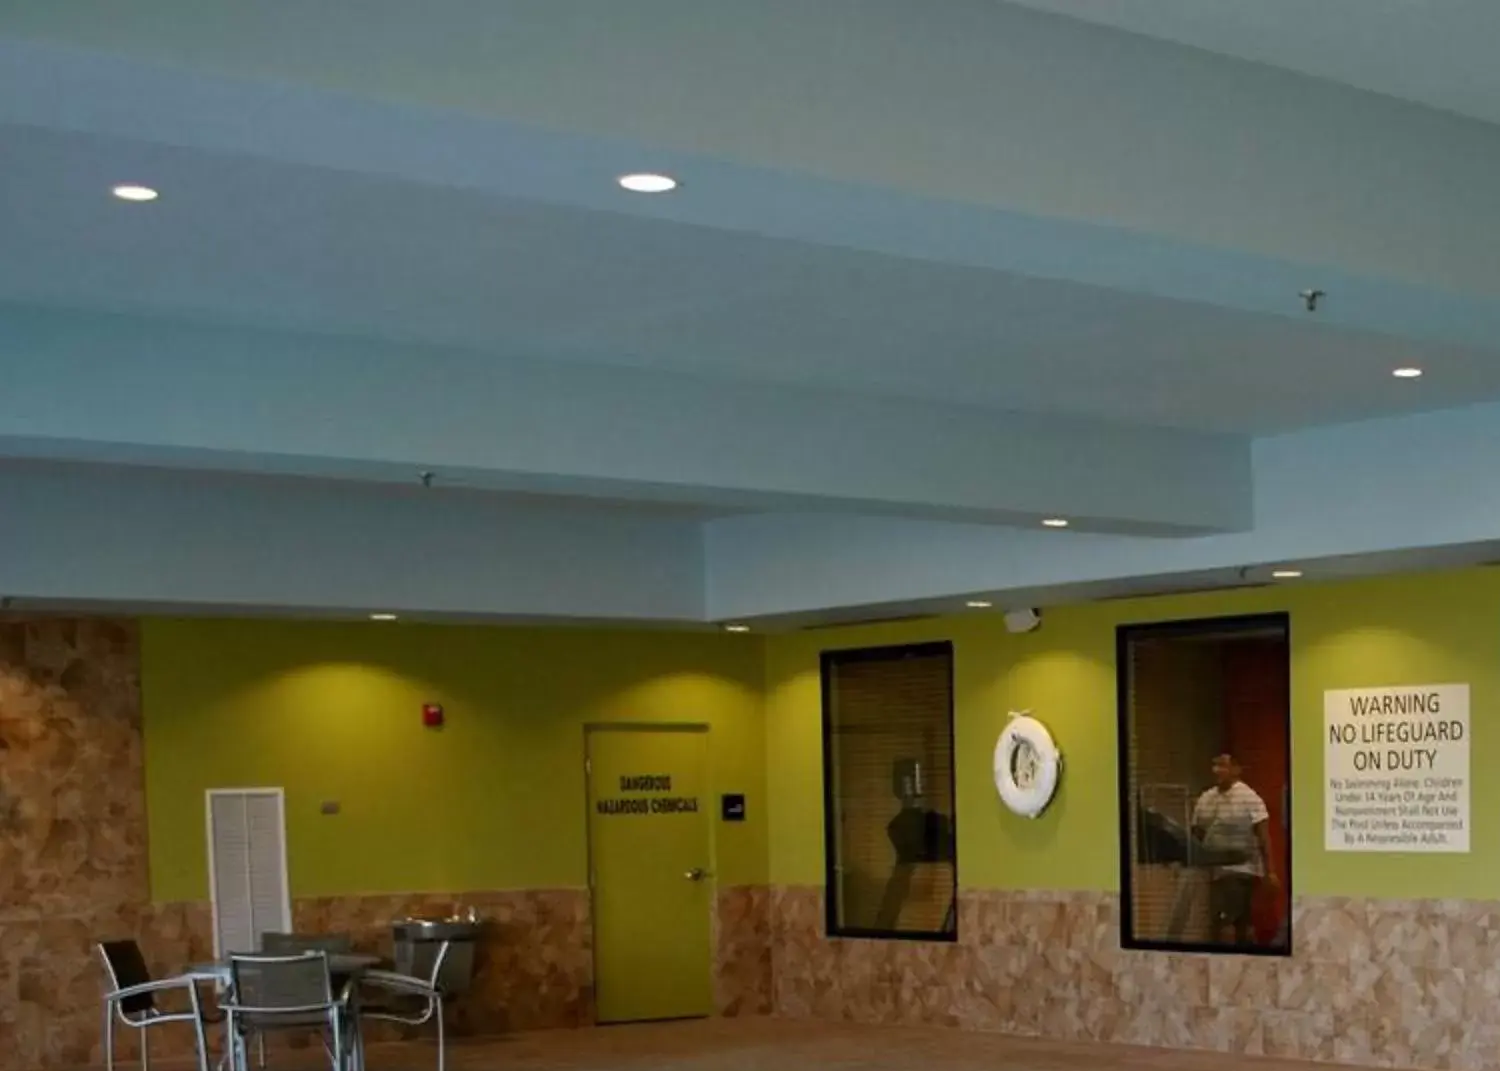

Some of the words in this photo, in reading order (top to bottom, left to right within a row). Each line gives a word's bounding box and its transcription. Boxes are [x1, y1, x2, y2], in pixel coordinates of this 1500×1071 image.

[1350, 693, 1440, 715] WARNING
[1330, 724, 1356, 744] NO
[1362, 720, 1463, 743] LIFEGUARD
[1354, 751, 1381, 771] ON
[1387, 749, 1437, 770] DUTY
[1330, 779, 1342, 789] No
[1345, 779, 1390, 790] Swimming
[1424, 778, 1462, 788] Children
[1335, 792, 1360, 802] Under
[1366, 792, 1375, 801] 14
[1378, 792, 1402, 802] Years
[1417, 792, 1435, 804] Age
[1438, 791, 1457, 801] And
[1422, 806, 1438, 816] Not
